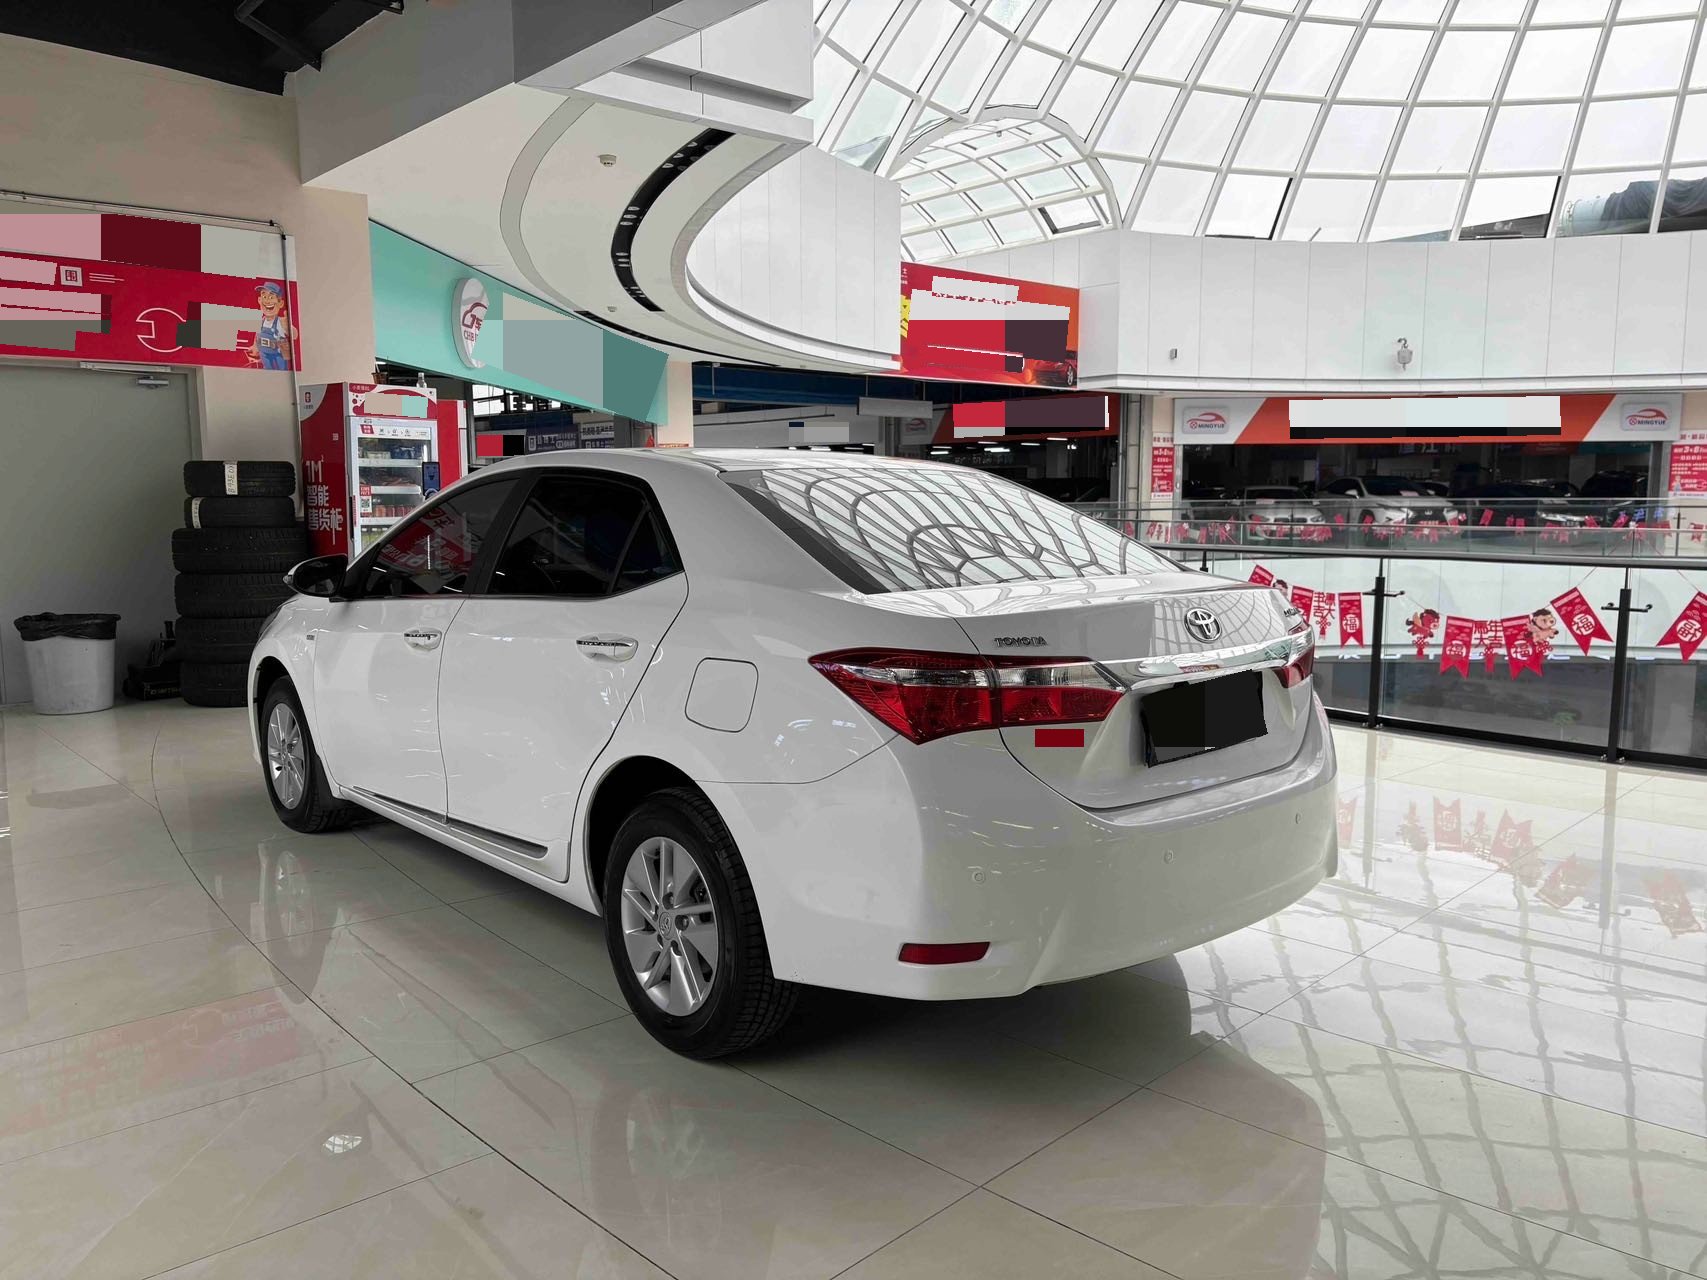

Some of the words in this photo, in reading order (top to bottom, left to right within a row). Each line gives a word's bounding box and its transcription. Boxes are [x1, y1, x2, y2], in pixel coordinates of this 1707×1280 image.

[307, 485, 329, 506] 智能
[308, 507, 343, 546] 售货柜
[1343, 616, 1359, 631] 福
[1571, 614, 1594, 636] 福
[994, 637, 1048, 647] TOYOTA
